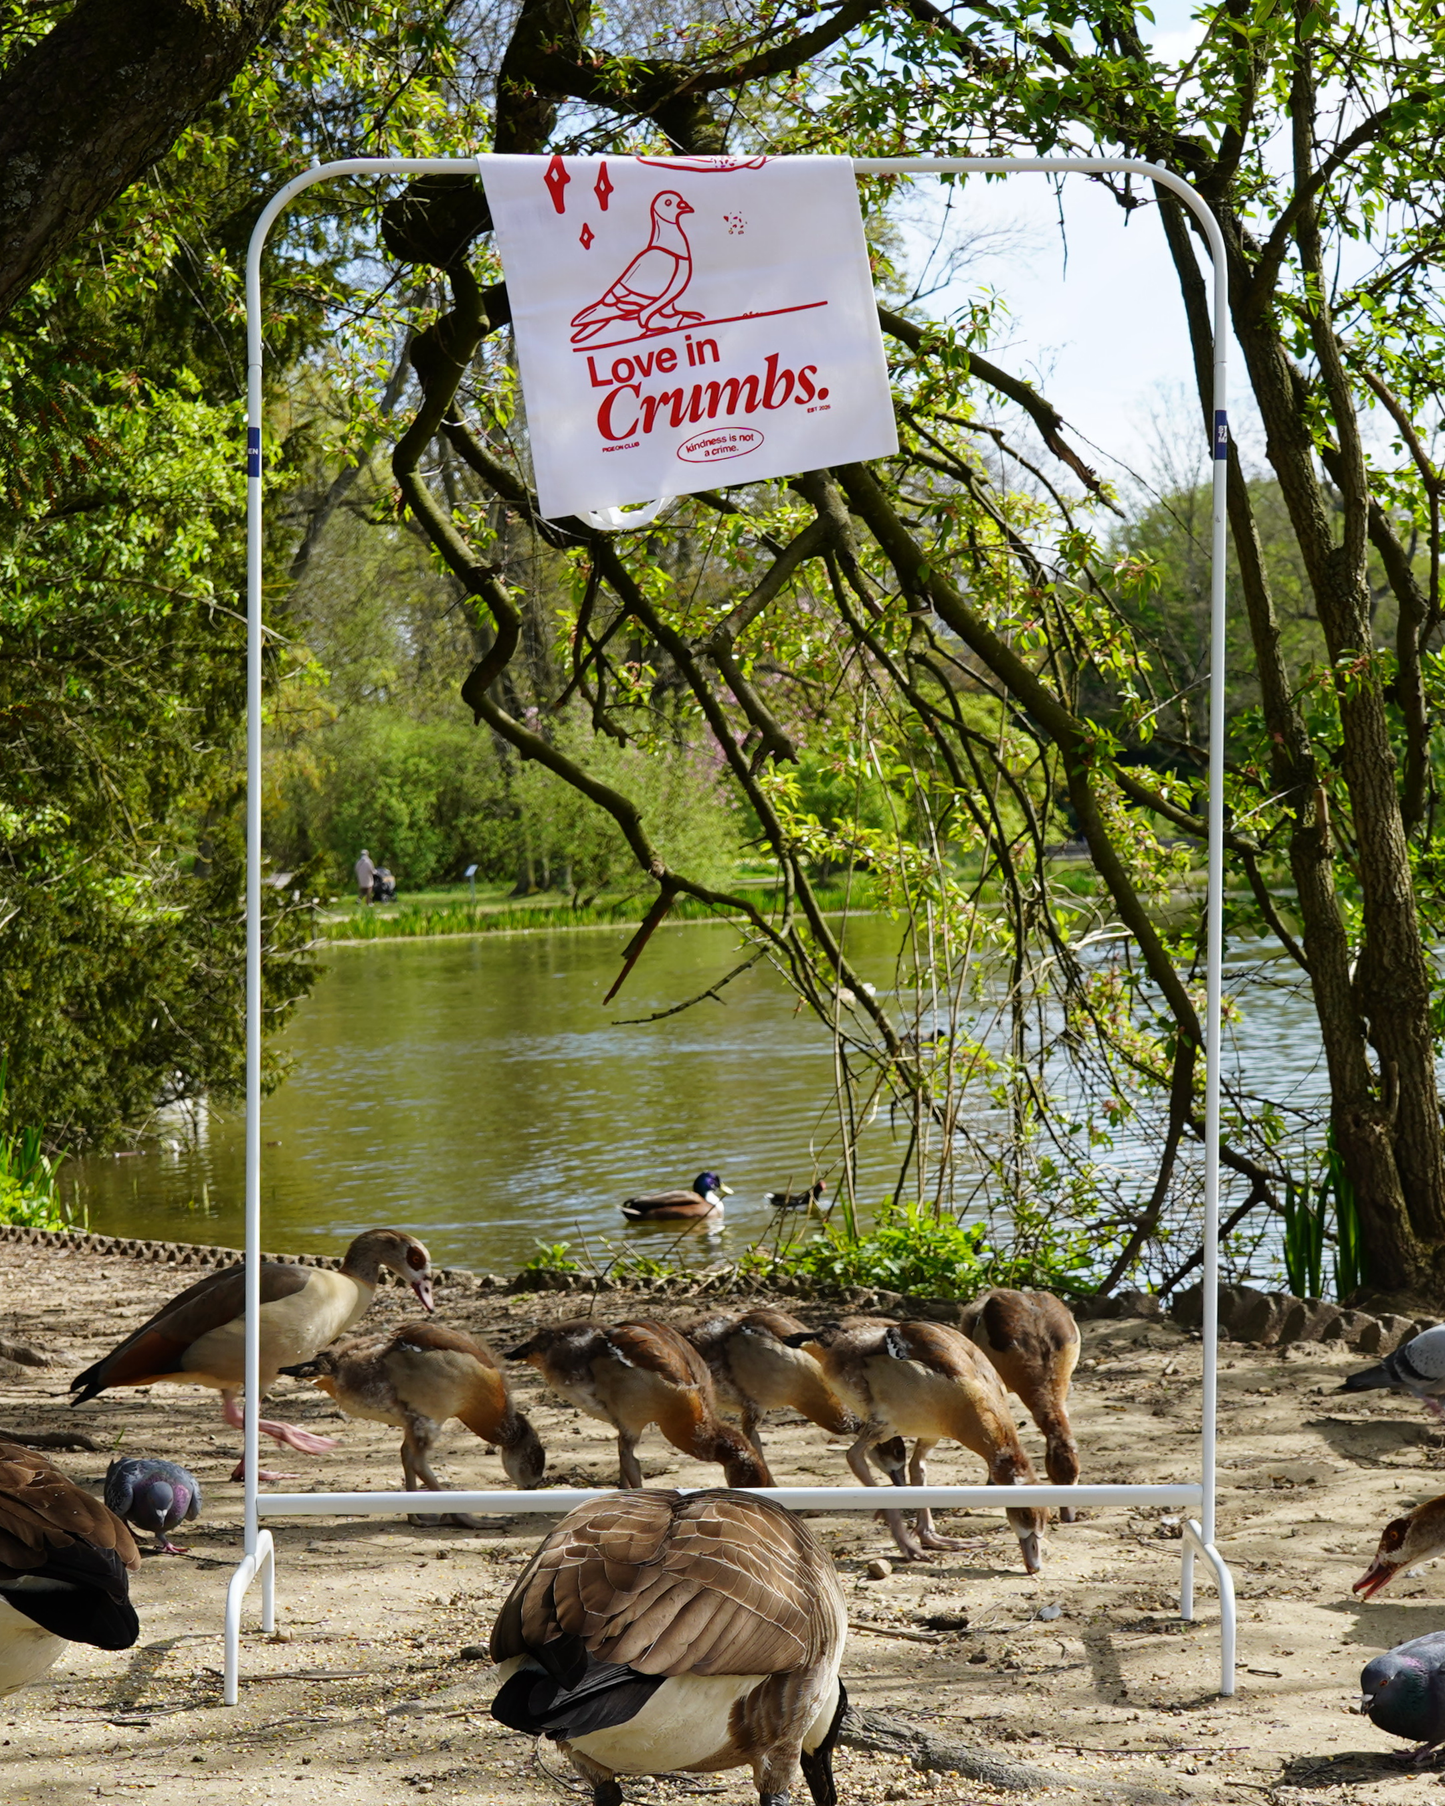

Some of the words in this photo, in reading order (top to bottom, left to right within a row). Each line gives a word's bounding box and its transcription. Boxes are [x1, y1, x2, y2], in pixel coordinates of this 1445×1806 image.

[587, 348, 677, 387] Love
[685, 334, 720, 366] in
[597, 352, 829, 441] Crumbs.
[624, 441, 640, 449] CLUB
[685, 437, 727, 453] kindness
[729, 433, 737, 442] is
[739, 433, 754, 442] not
[711, 445, 739, 456] crime.
